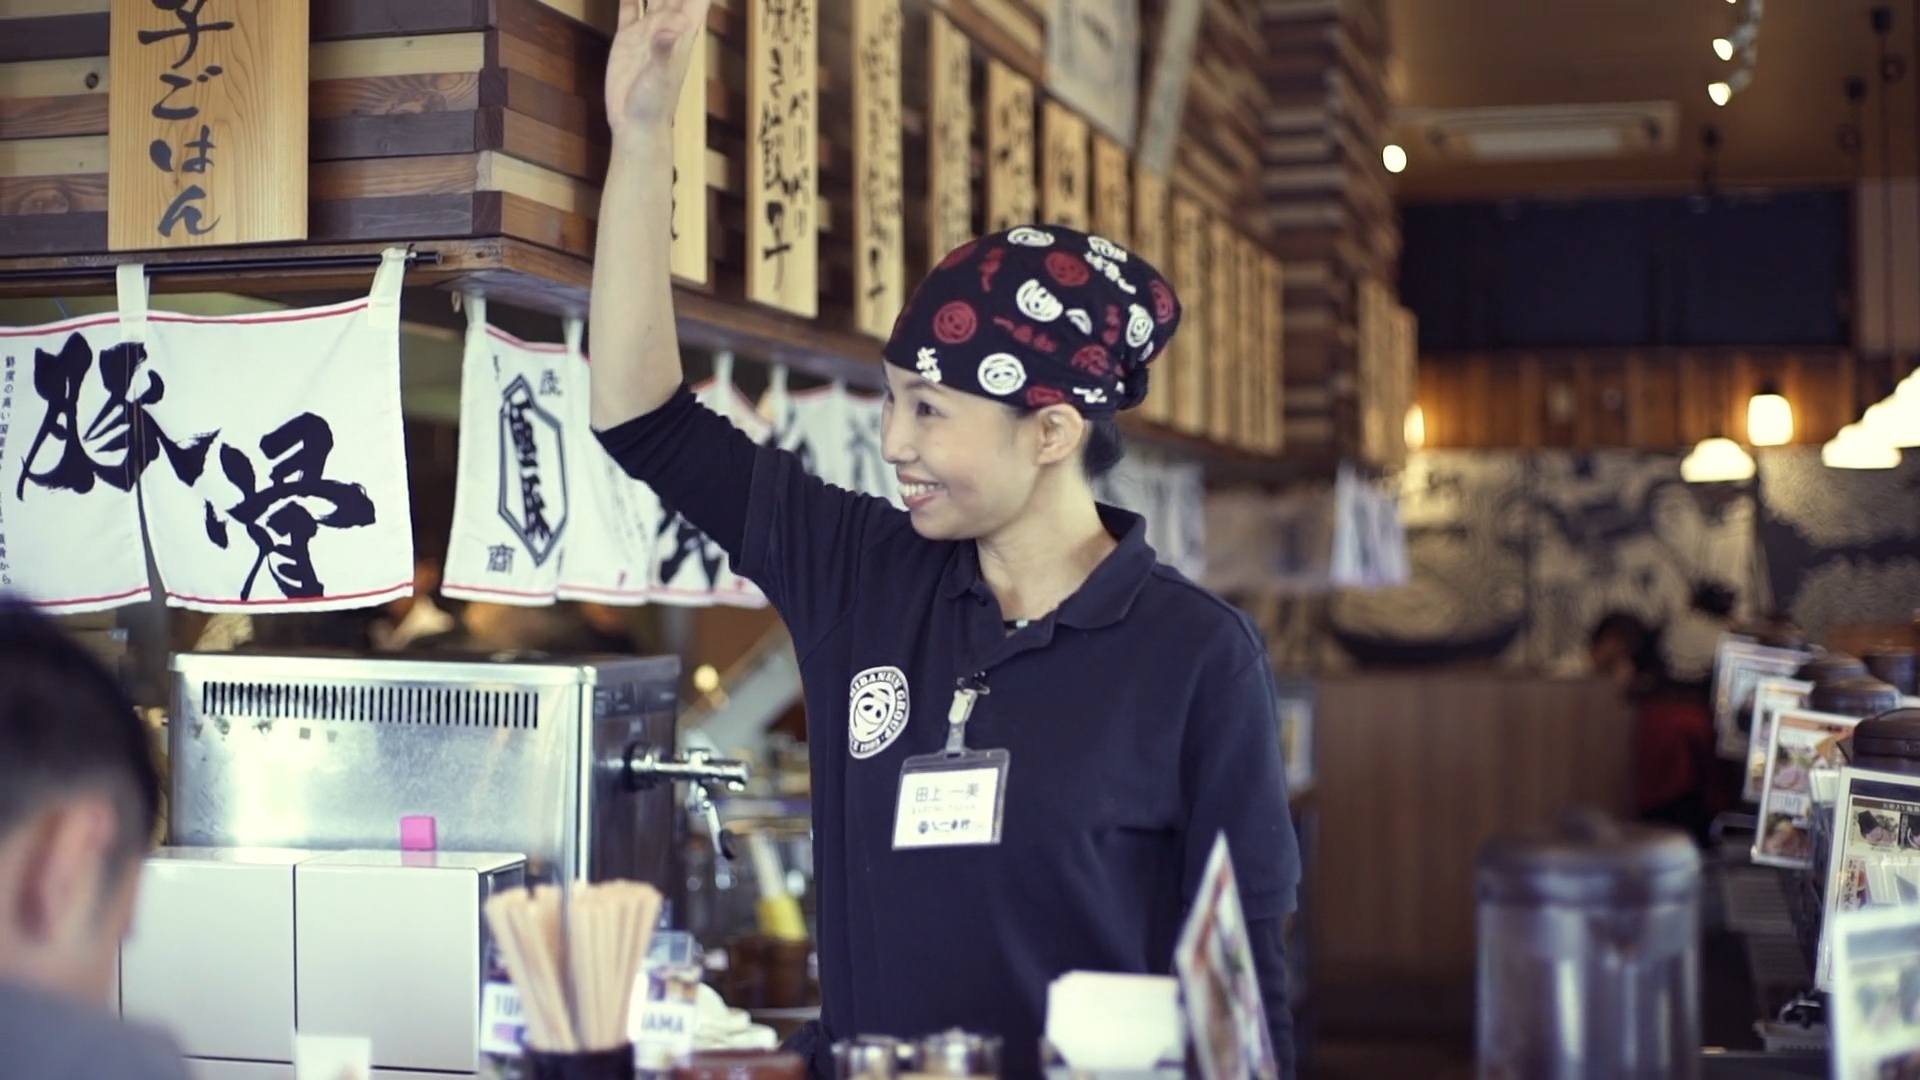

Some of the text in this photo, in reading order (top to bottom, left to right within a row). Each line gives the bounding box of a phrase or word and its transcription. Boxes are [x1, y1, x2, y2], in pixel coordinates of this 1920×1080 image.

[138, 0, 234, 237] 子ごはん
[17, 331, 376, 600] 豚骨
